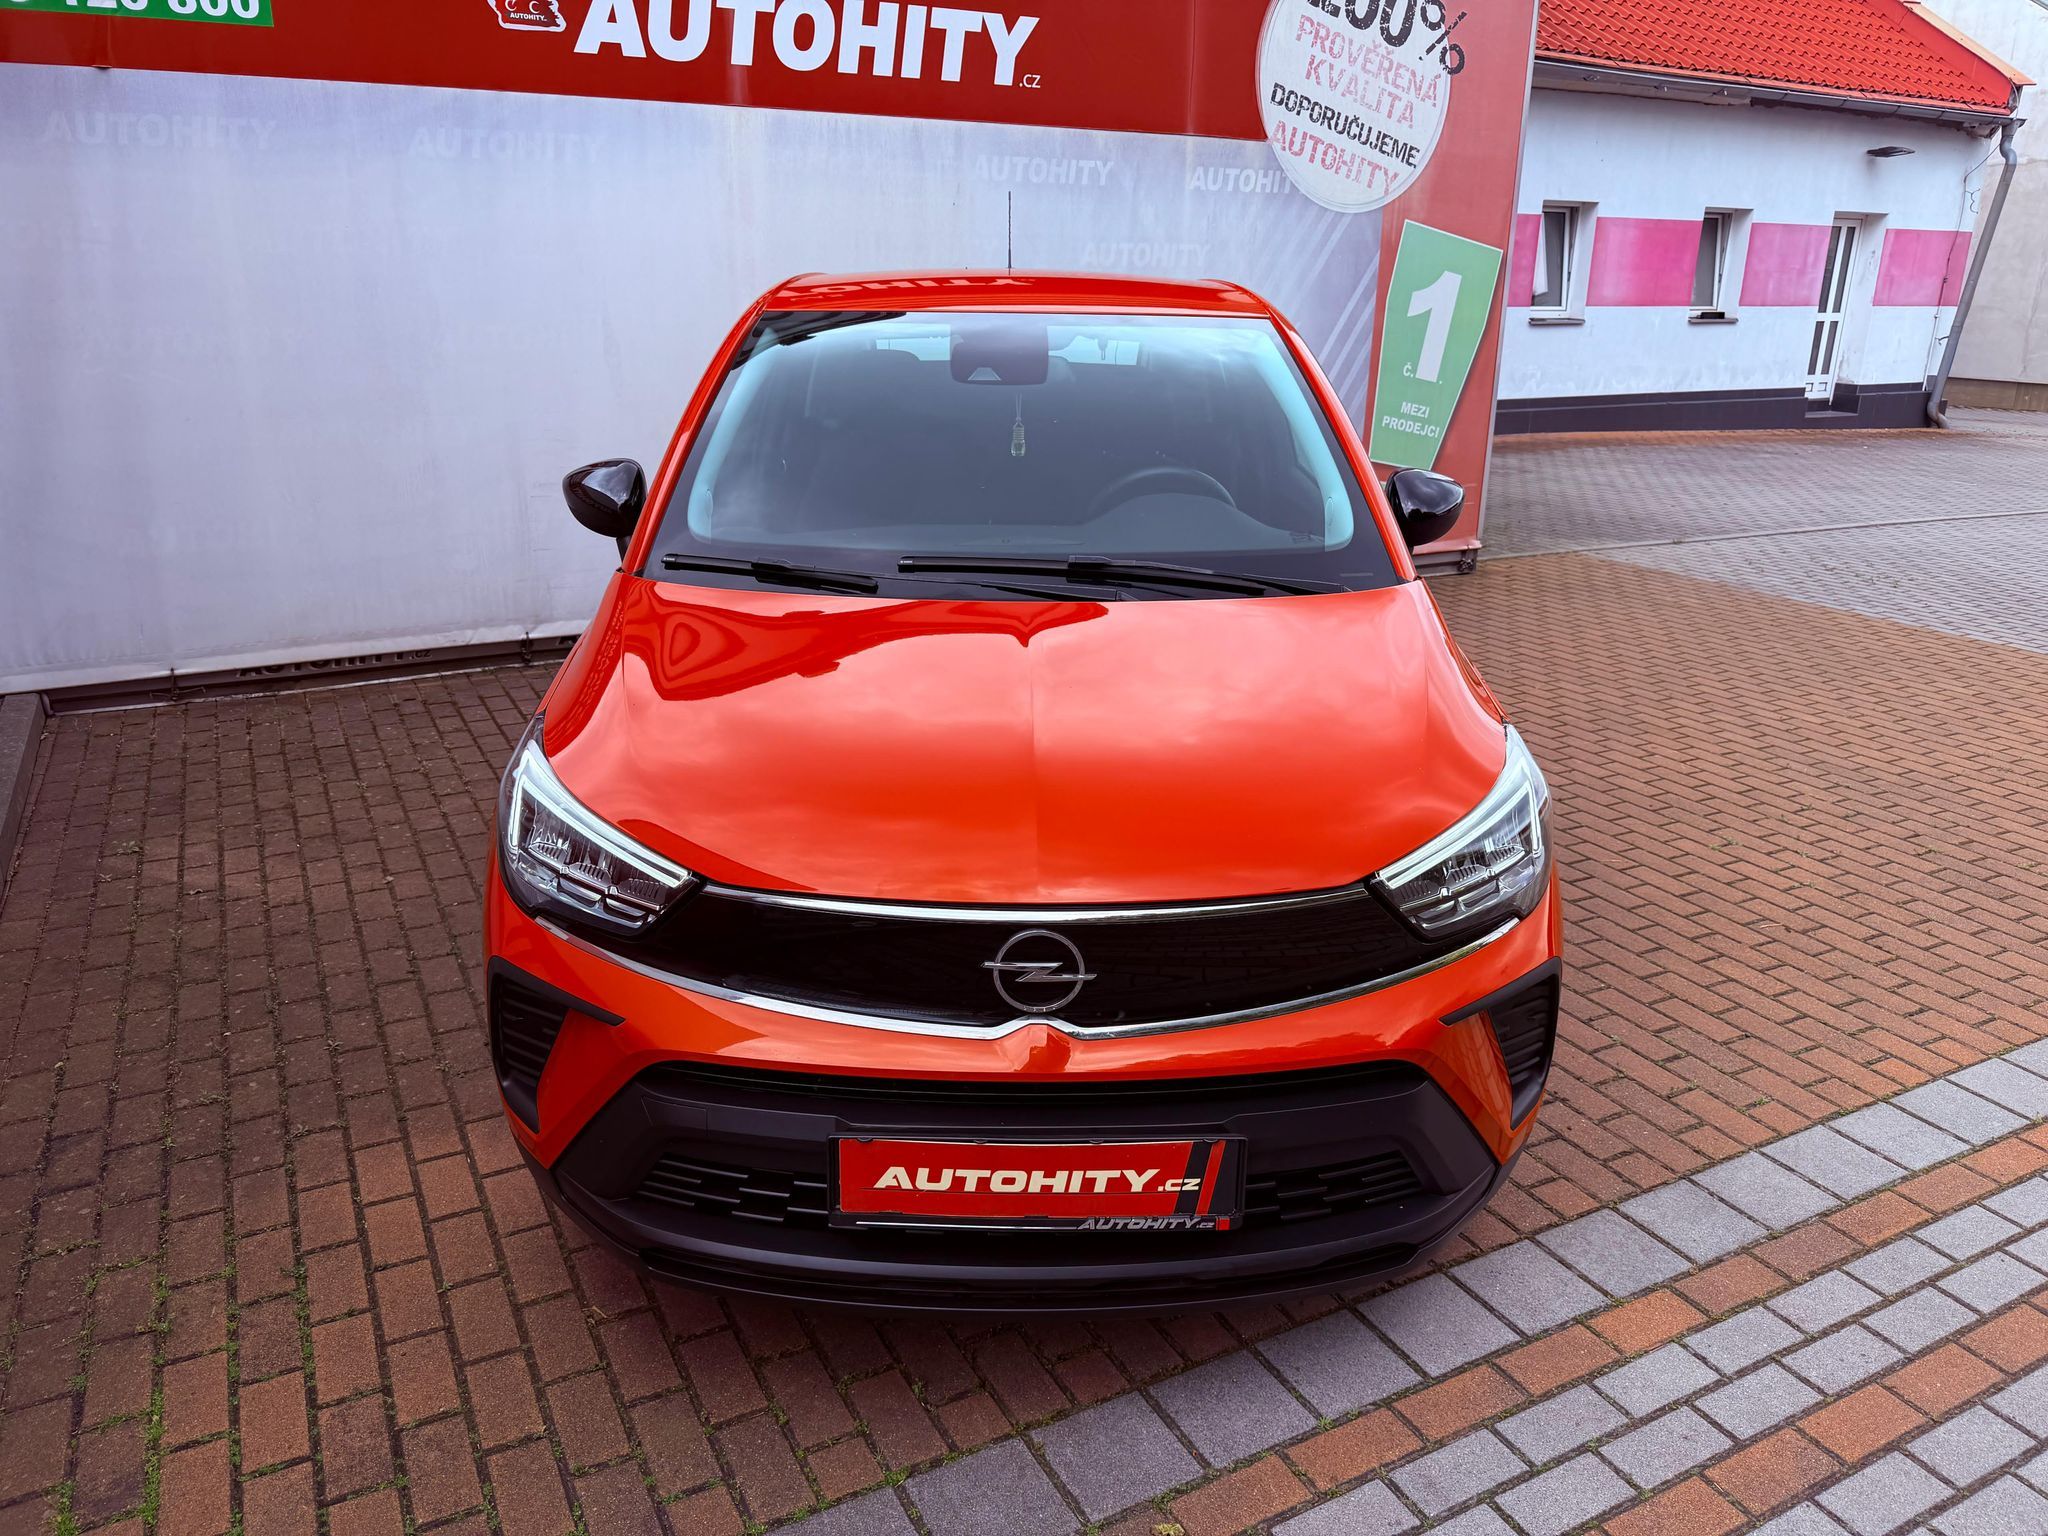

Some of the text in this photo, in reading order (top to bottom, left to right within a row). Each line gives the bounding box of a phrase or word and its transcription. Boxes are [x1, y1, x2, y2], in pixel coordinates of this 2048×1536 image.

[1296, 15, 1441, 107] PROVĚŘENÁ
[1305, 54, 1414, 128] KVALITA
[42, 111, 278, 151] AUTOHITY
[1270, 82, 1420, 168] DOPORUČUJEME
[973, 155, 1115, 187] AUTOHITY
[1266, 120, 1399, 196] AUTOHITY
[1187, 166, 1292, 194] AUTOHIT
[1082, 242, 1210, 269] AUTOHITY
[1401, 402, 1429, 419] MEZI
[1382, 416, 1440, 438] PRODEJCI
[873, 1166, 1200, 1193] AUTOHITY.cz
